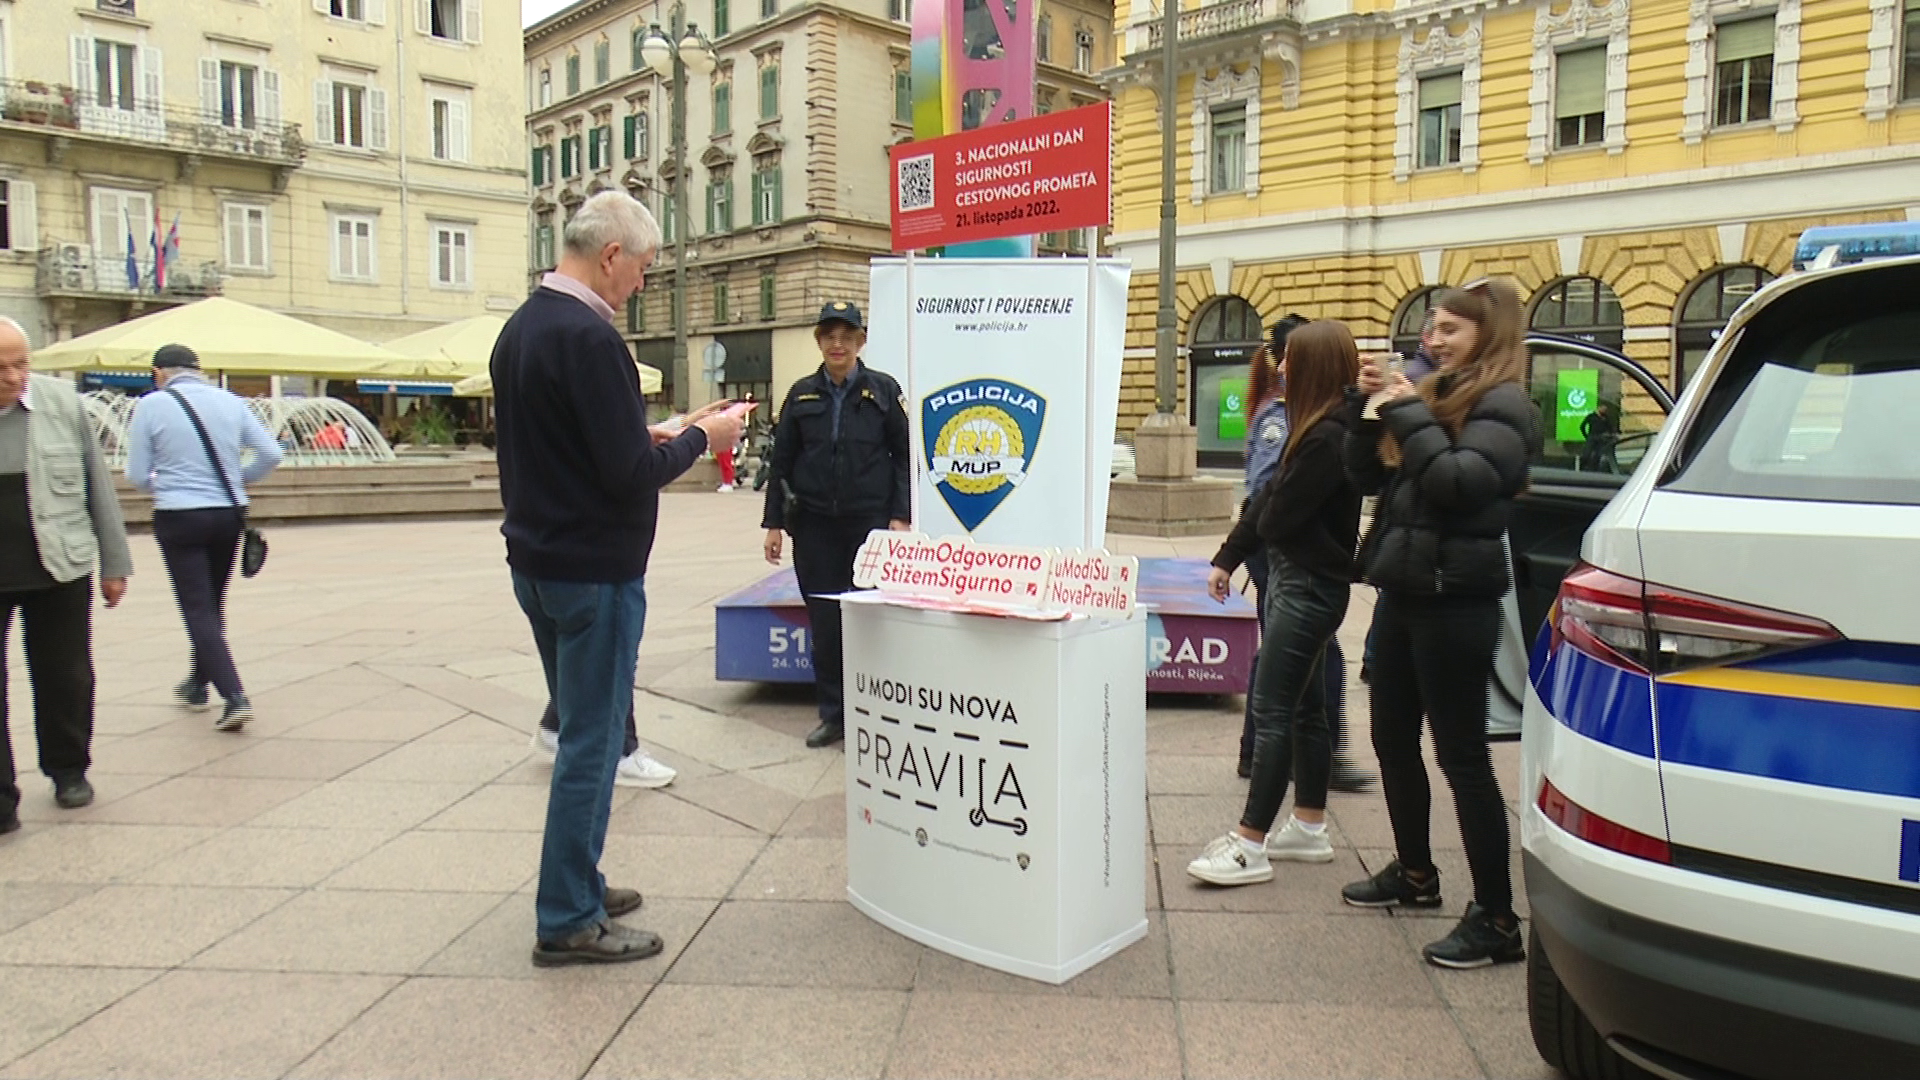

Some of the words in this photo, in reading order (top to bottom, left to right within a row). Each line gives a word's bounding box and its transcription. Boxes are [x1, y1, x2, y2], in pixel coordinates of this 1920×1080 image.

[955, 151, 966, 166] 3.
[968, 133, 1051, 164] NACIONALNI
[1053, 127, 1084, 148] DAN
[955, 160, 1032, 187] SIGURNOSTI
[955, 181, 1031, 207] CESTOVNOG
[1033, 171, 1098, 196] PROMETA
[956, 213, 971, 228] 21.
[973, 205, 1024, 226] listopada
[1026, 200, 1060, 218] 2022.
[916, 297, 985, 314] SIGURNOST
[986, 298, 993, 314] I
[995, 297, 1074, 314] POVJERENJE
[955, 321, 1028, 333] www.policija.hr
[929, 385, 1039, 415] POLICIJA
[955, 430, 1002, 456] RH
[951, 460, 1001, 474] MUP
[881, 561, 1013, 595] StižemSigurno
[1052, 581, 1127, 610] NovaPravila
[855, 672, 865, 693] U
[869, 675, 913, 706] MODI
[918, 687, 942, 712] SU
[950, 691, 1018, 724] NOVA
